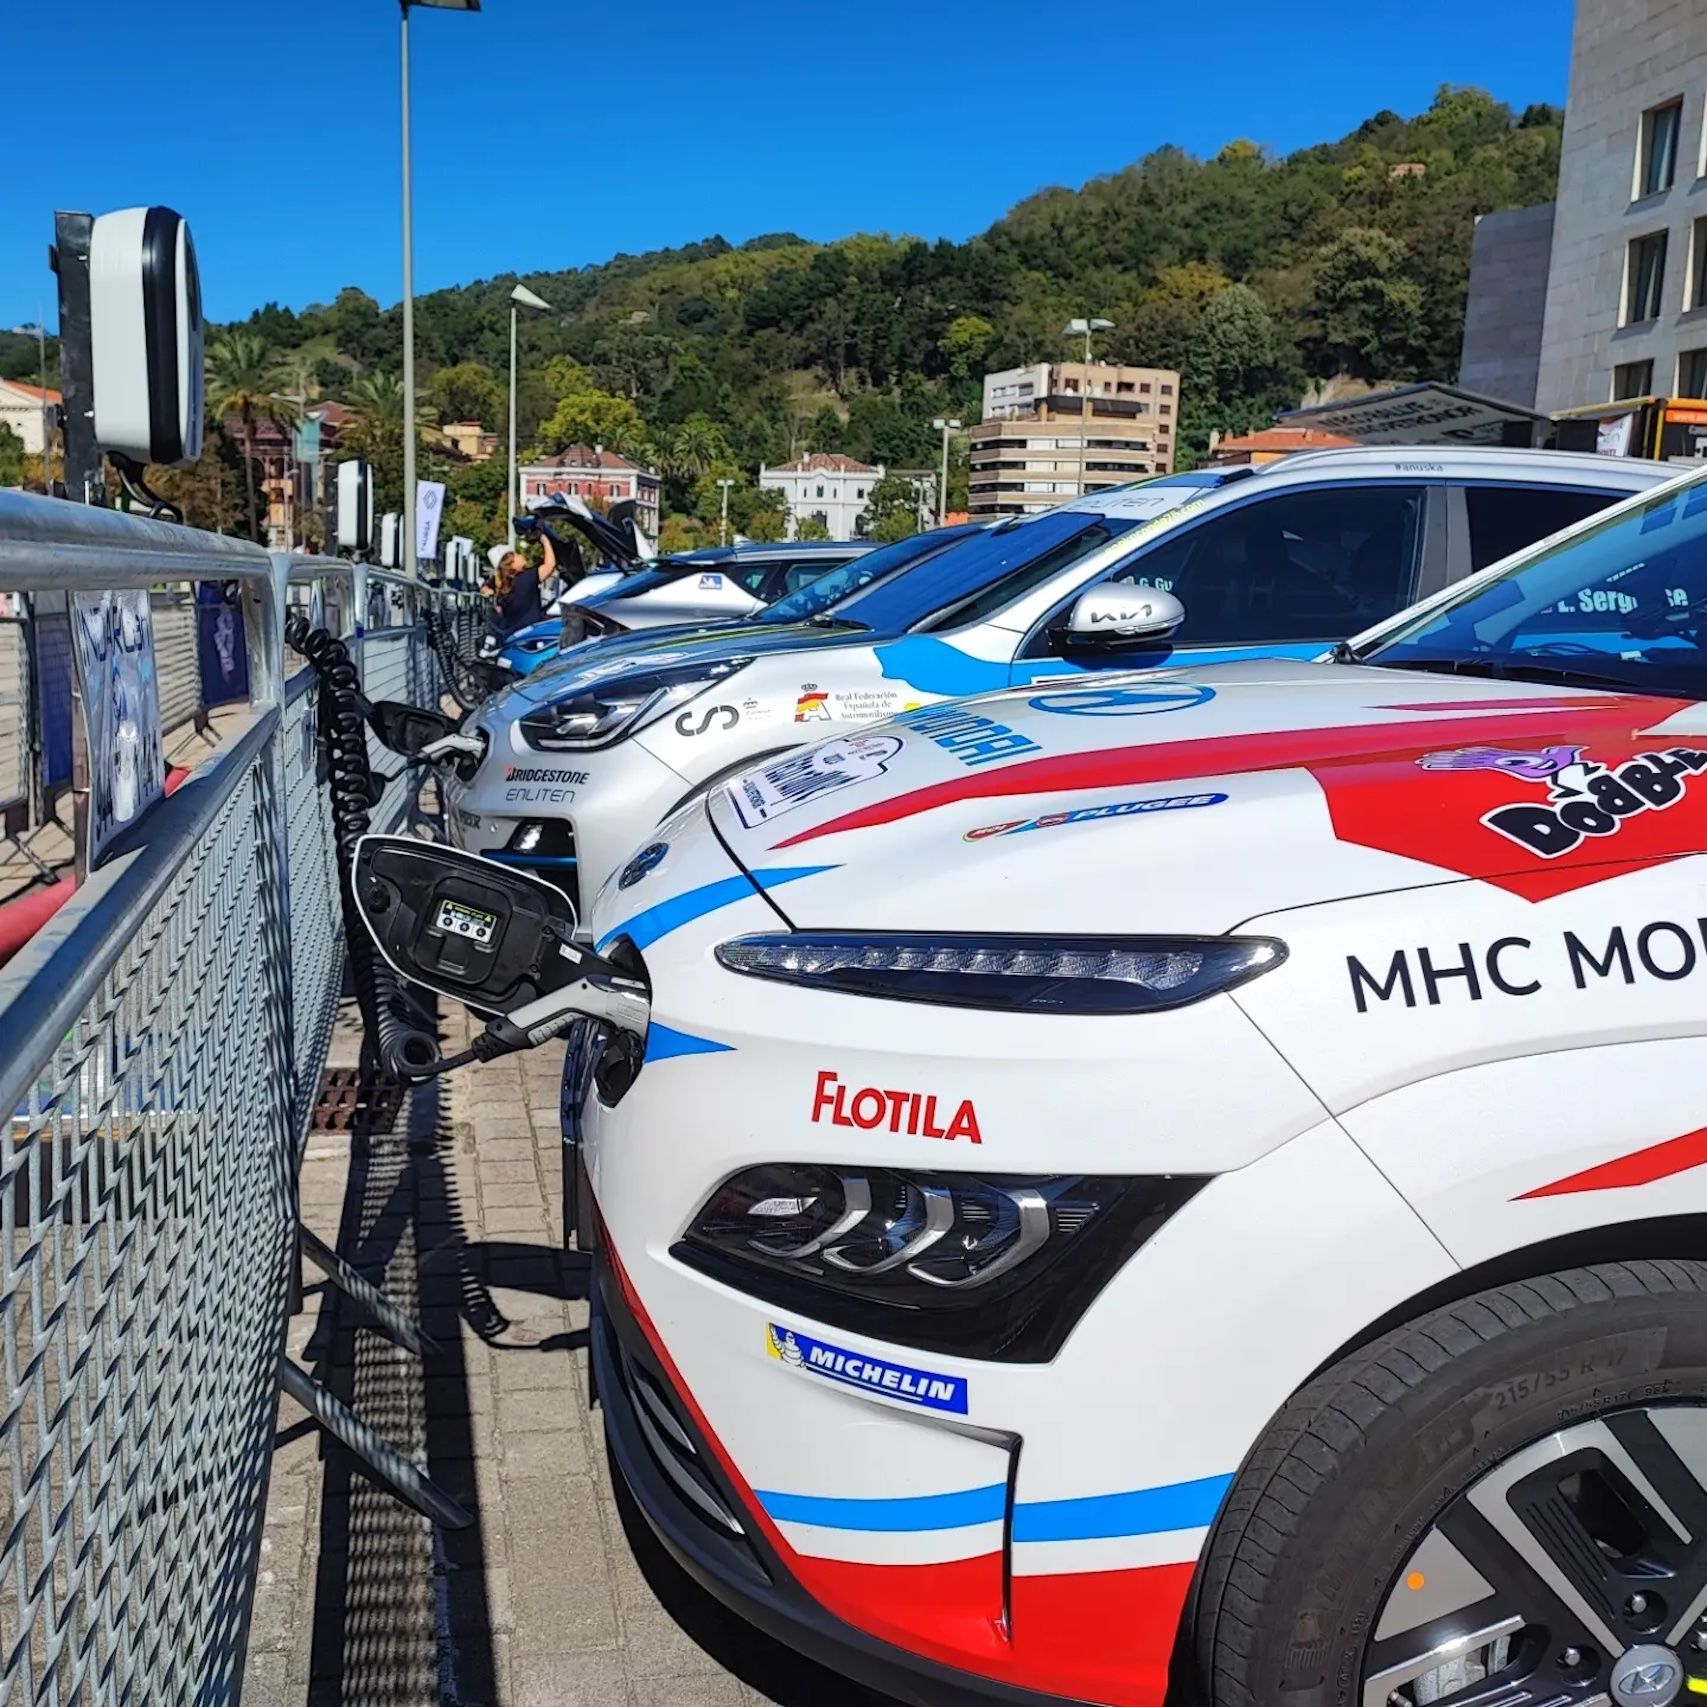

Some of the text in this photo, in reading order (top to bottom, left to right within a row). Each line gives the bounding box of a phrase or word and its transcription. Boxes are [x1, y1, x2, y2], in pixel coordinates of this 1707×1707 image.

[505, 788, 576, 803] ENLITEN
[506, 765, 590, 785] BRIDGESTONE
[1346, 917, 1707, 1013] MHC MO
[811, 1070, 983, 1144] FLOTILA
[808, 1345, 956, 1402] MICHELIN
